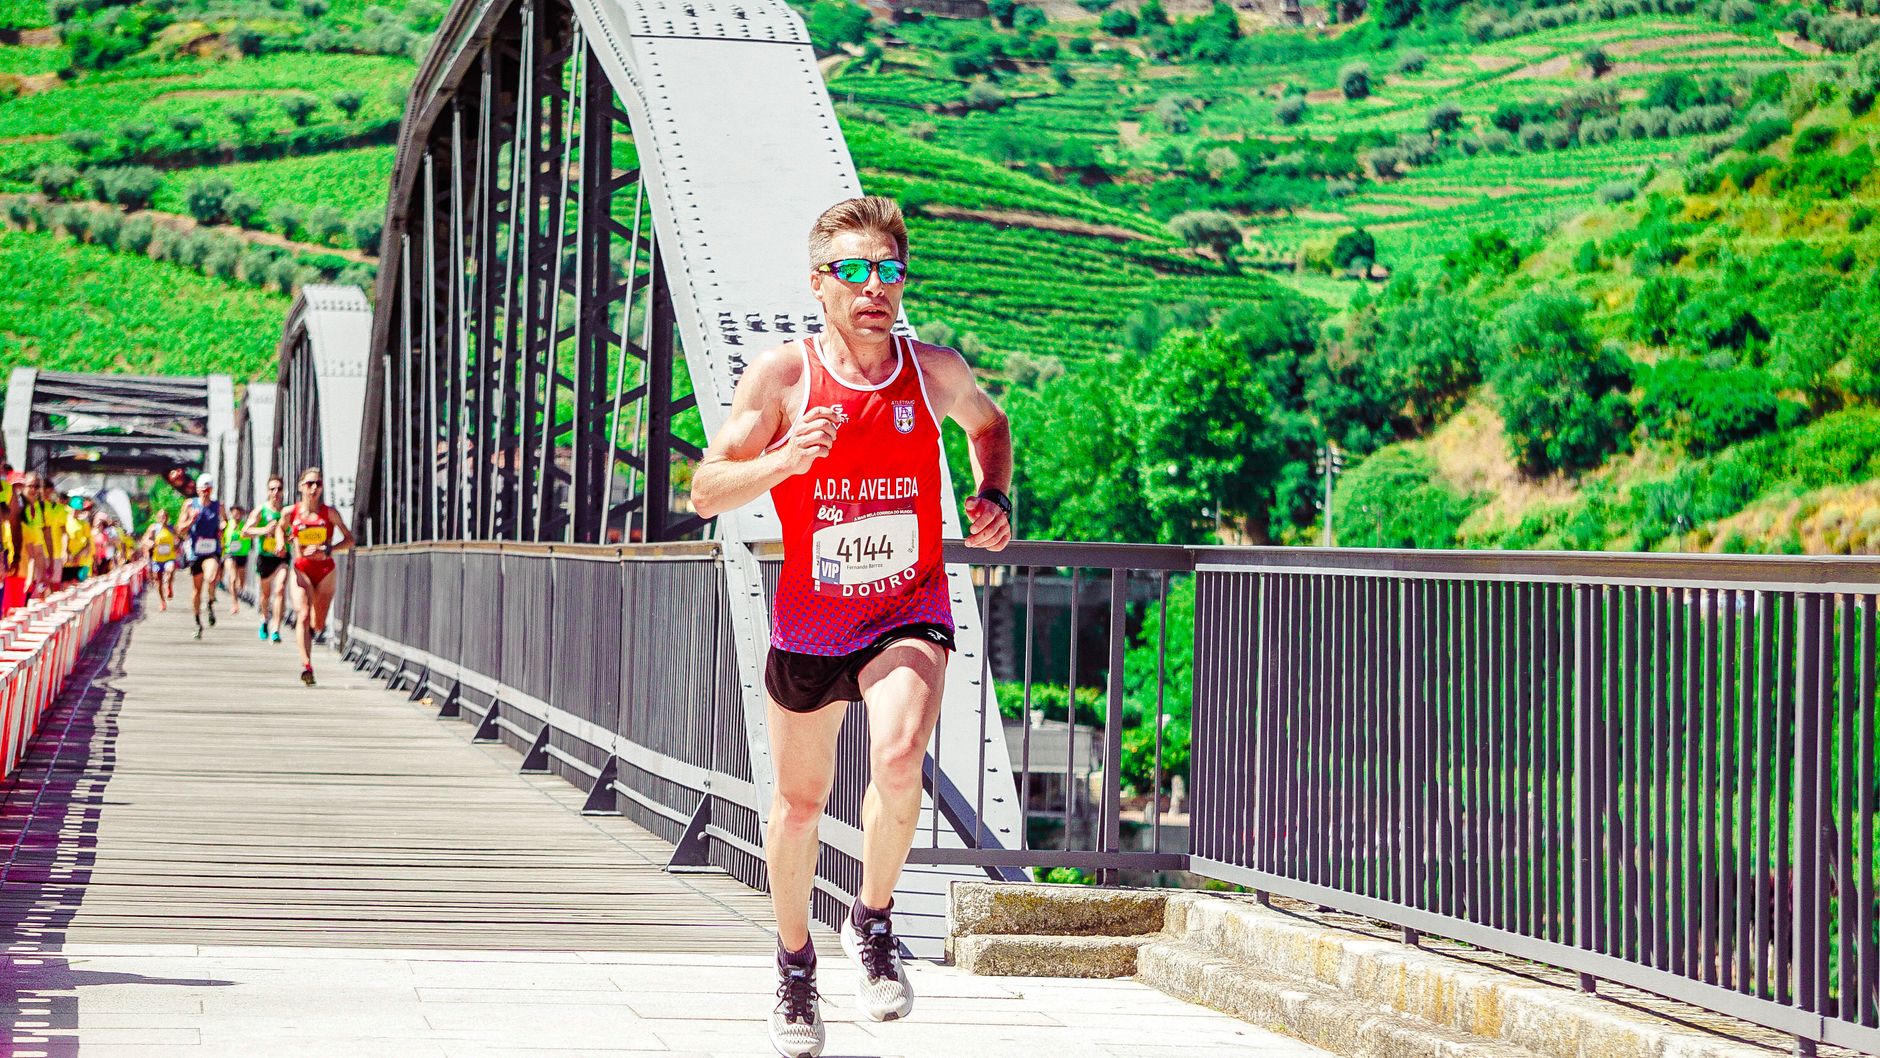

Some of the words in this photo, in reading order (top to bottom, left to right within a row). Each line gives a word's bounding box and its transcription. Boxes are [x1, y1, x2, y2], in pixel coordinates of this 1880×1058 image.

[814, 478, 854, 500] A.D.R.
[858, 477, 919, 500] AVELEDA
[817, 504, 844, 526] edp
[836, 534, 894, 563] 4144
[821, 560, 840, 579] VIP
[842, 567, 916, 597] DOURO
